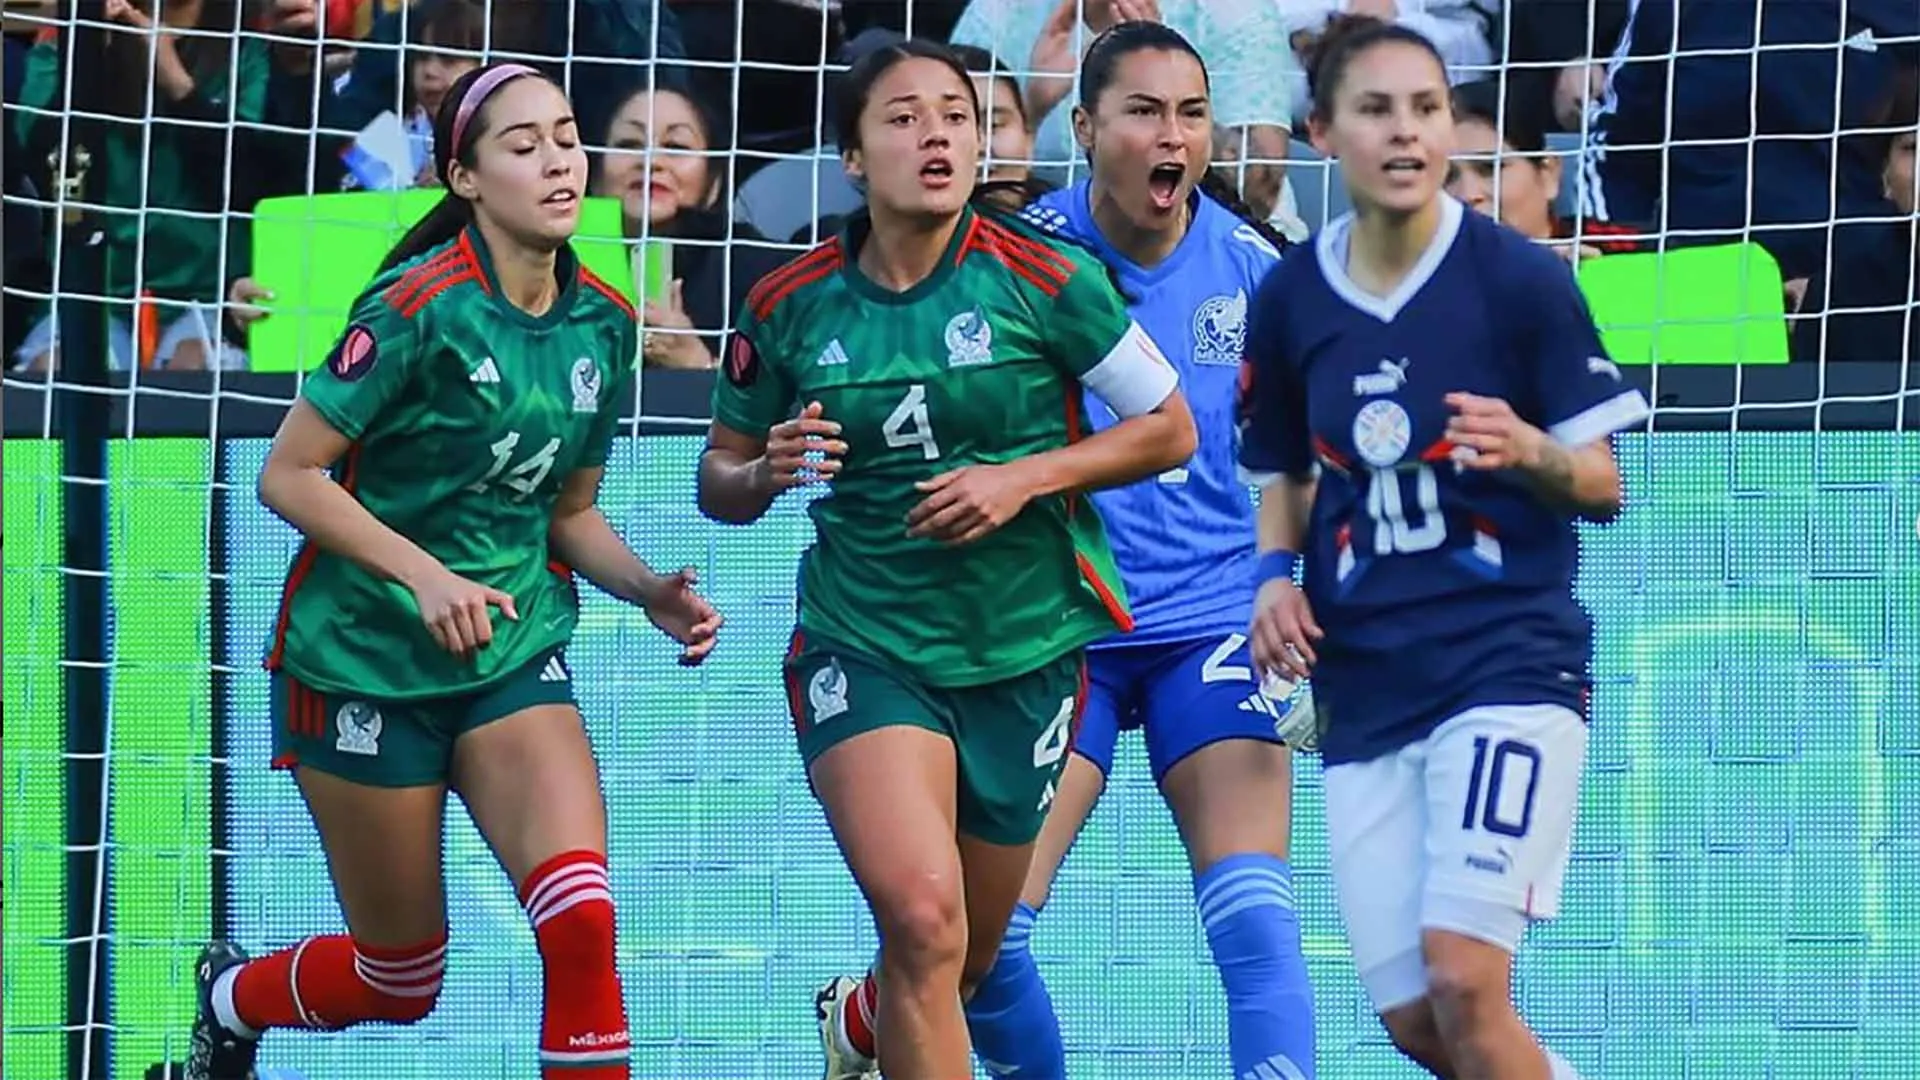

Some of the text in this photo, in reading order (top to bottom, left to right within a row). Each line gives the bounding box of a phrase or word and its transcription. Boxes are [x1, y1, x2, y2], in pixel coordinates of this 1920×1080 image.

[882, 384, 940, 460] 4
[469, 430, 561, 501] 14
[1367, 466, 1448, 555] 10
[1033, 696, 1074, 771] 4
[1462, 736, 1542, 839] 10
